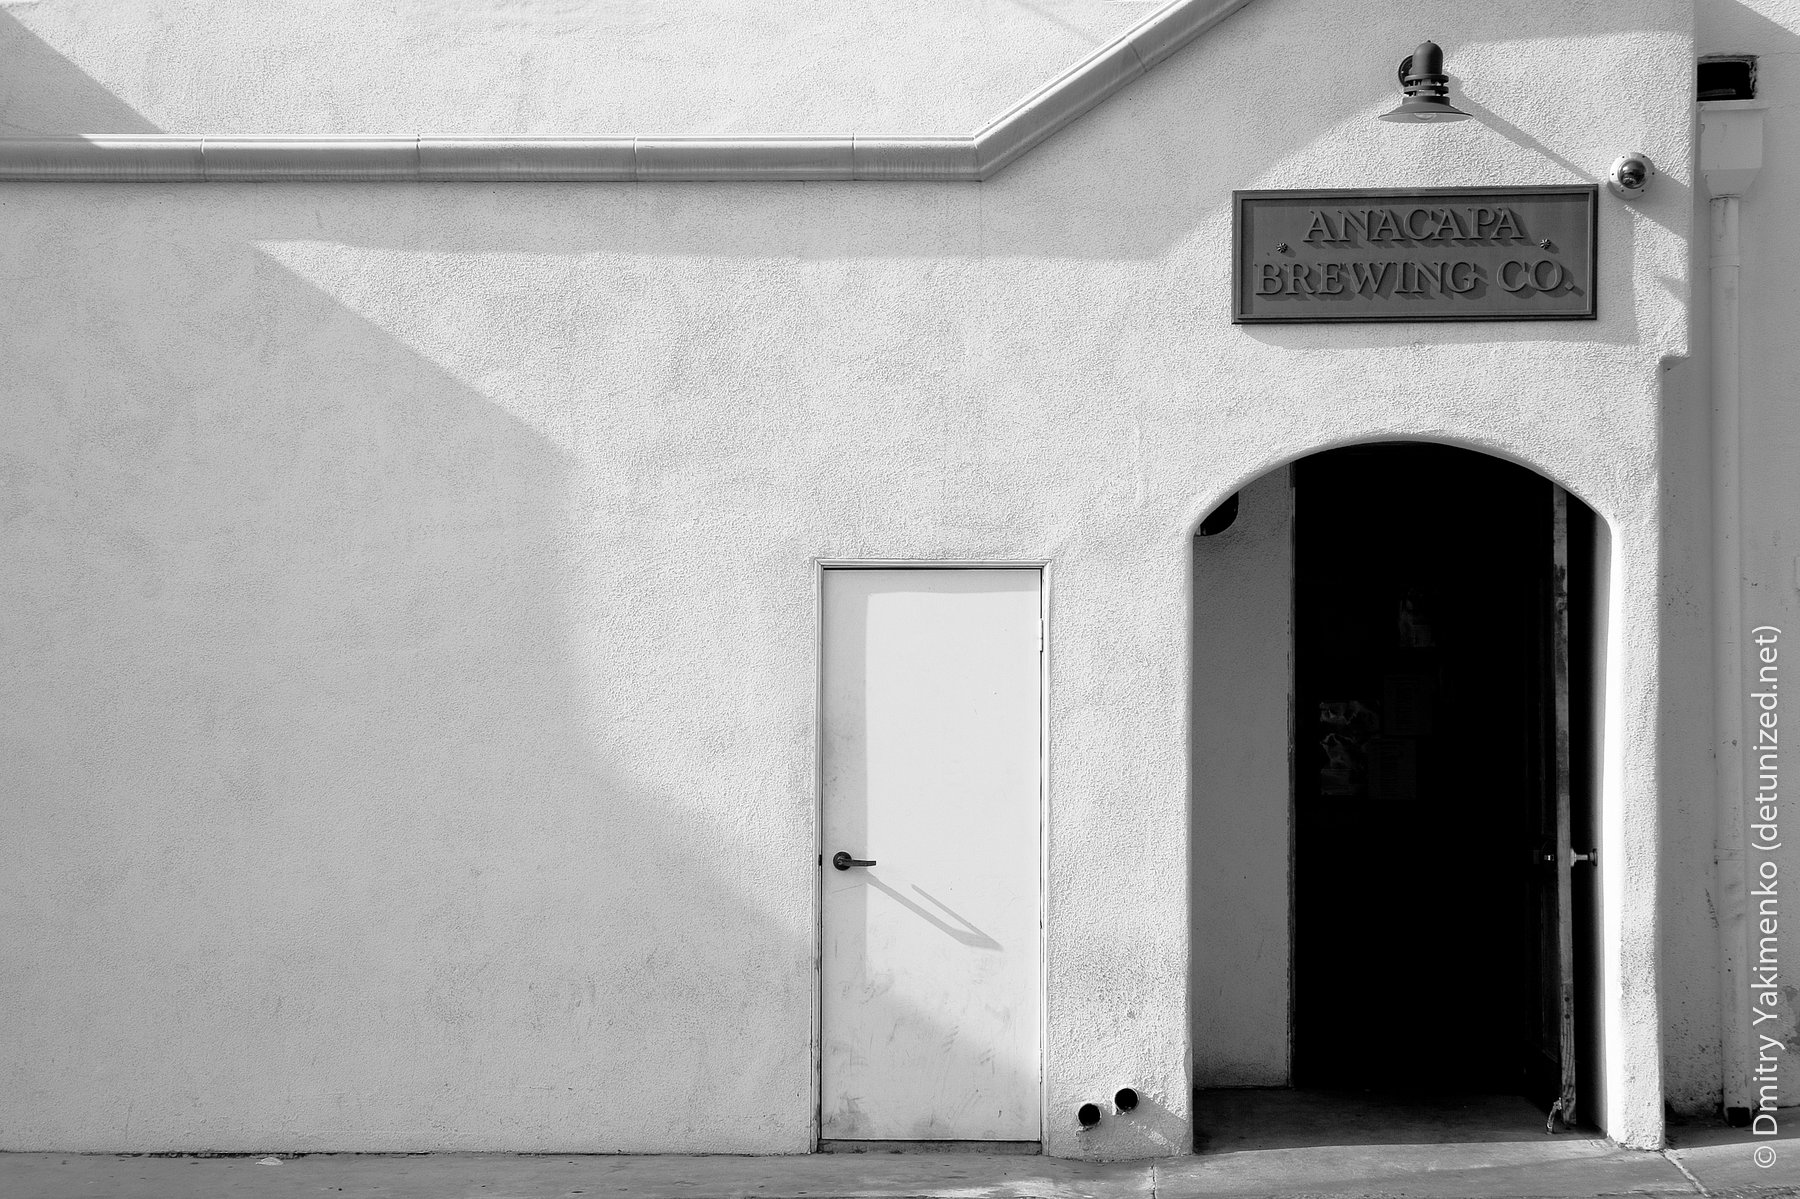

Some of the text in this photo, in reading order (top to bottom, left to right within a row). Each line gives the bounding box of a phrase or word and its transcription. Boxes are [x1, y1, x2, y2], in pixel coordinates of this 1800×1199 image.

[1303, 206, 1524, 242] ANACAPA
[1255, 259, 1576, 296] BREWING CO.
